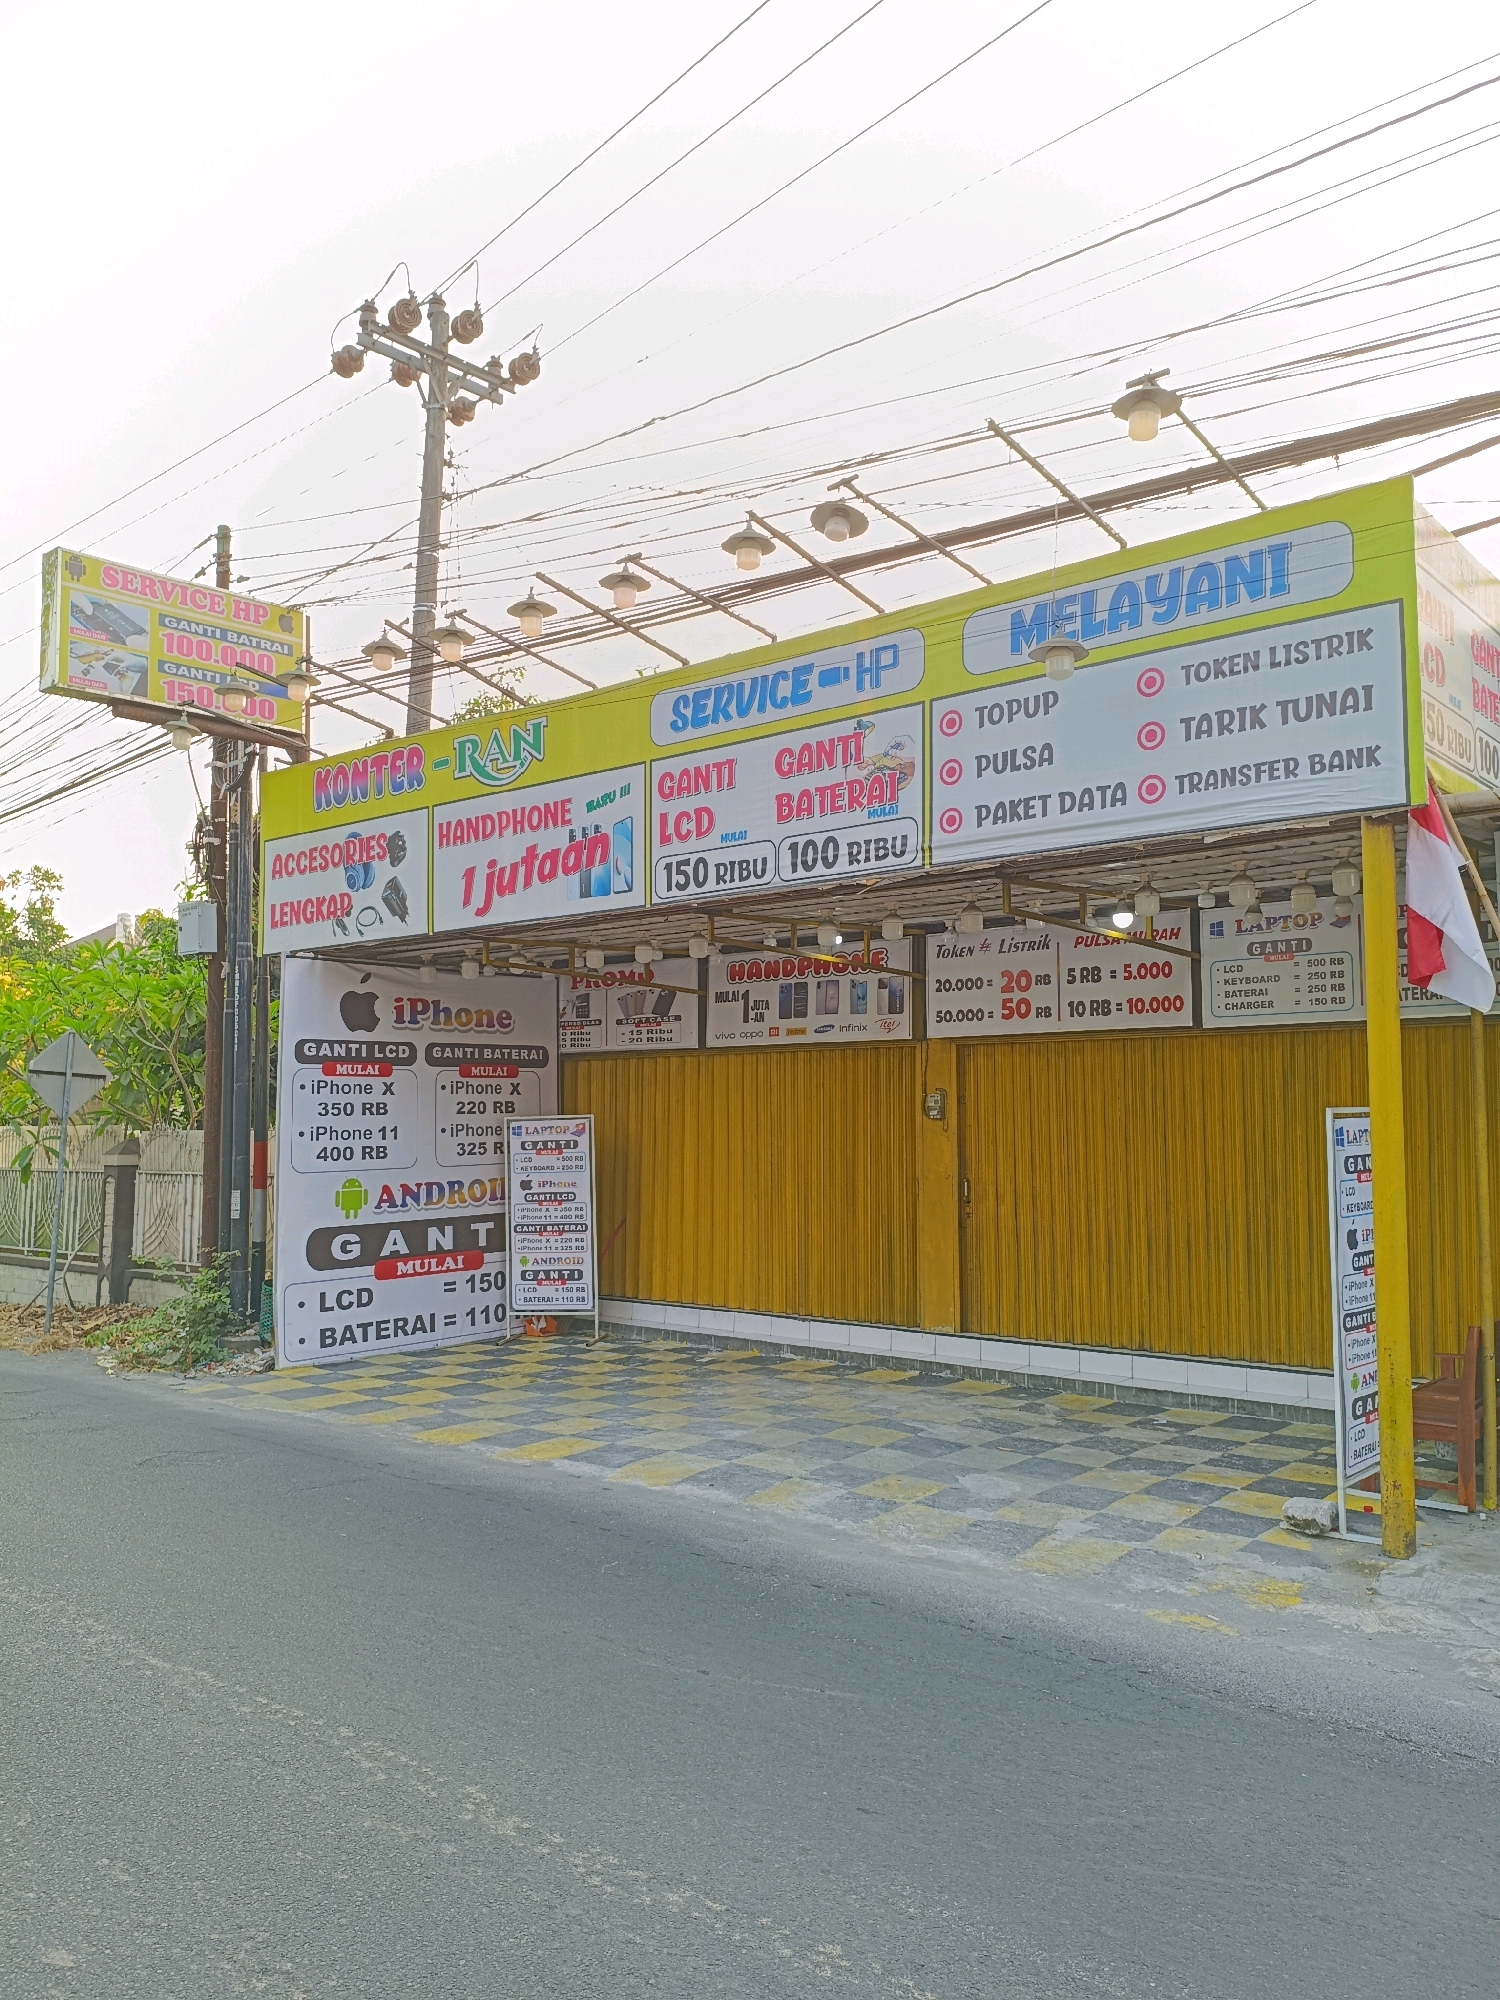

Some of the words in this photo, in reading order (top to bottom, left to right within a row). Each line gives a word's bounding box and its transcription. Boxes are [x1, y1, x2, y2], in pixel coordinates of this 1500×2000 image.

[102, 565, 225, 616] SERVICE
[232, 600, 269, 625] HP
[1009, 541, 1293, 656] MELAYANI
[73, 628, 92, 638] MULAI
[164, 616, 221, 639] GANTI
[226, 630, 289, 655] BATRAI
[161, 631, 274, 677] 100.000
[1180, 649, 1261, 687] TOKEN
[1268, 626, 1375, 670] LISTRIK
[1420, 641, 1446, 687] CD
[72, 678, 91, 686] MULAI
[163, 662, 220, 684] GANTI
[670, 662, 815, 733] SERVICE
[855, 643, 900, 693] HP
[974, 689, 1060, 730] TOPUP
[1472, 676, 1500, 727] BATE
[1179, 702, 1268, 744] TARIK
[1275, 683, 1375, 727] TUNAI
[774, 730, 867, 780] GANTI
[1446, 724, 1472, 764] RIBU
[313, 743, 426, 813] KONTER
[453, 716, 548, 786] RAN
[974, 742, 1055, 779] PULSA
[1174, 755, 1300, 797] TRANSFER
[1307, 744, 1383, 777] BANK
[657, 757, 738, 802] GANTI
[775, 770, 900, 824] BATERAI
[974, 793, 1052, 830] PAKET
[1058, 780, 1128, 816] DATA
[437, 797, 573, 849] HANDPHONE
[585, 790, 617, 814] BARU
[867, 804, 900, 820] MULAI
[658, 805, 717, 847] LCD
[720, 830, 748, 844] MULAI
[271, 832, 389, 880] ACCESORIES
[787, 835, 840, 875] 100
[846, 834, 909, 867] RIBU
[461, 865, 477, 910] 1
[474, 830, 612, 917] jutaan
[663, 856, 709, 893] 150
[714, 856, 769, 887] RIBU
[270, 891, 353, 930] LENGKAP
[1252, 940, 1308, 954] GANTI
[1066, 967, 1077, 984] 5
[1080, 966, 1102, 984] RB
[1123, 960, 1173, 981] 5.000
[1224, 964, 1244, 974] LCD
[1307, 958, 1326, 968] 500
[1330, 957, 1345, 966] RB
[935, 976, 984, 993] 20.000
[1000, 969, 1033, 994] 20
[1034, 974, 1052, 986] RB
[1224, 975, 1281, 986] KEYBOARD
[1308, 972, 1327, 980] 250
[1330, 970, 1345, 979] RB
[1224, 988, 1268, 998] BATERAI
[1308, 984, 1327, 994] 250
[1330, 983, 1346, 992] RB
[392, 996, 514, 1032] iPhone
[714, 990, 740, 1004] MULAI
[741, 989, 750, 1024] 1
[750, 1000, 770, 1011] JUTA
[935, 1008, 985, 1024] 50.000
[1001, 997, 1032, 1021] 50
[1035, 1006, 1052, 1019] RB
[1068, 1000, 1087, 1018] 10
[1090, 998, 1112, 1017] RB
[1126, 994, 1185, 1014] 10.000
[1224, 1000, 1274, 1011] CHARGER
[1308, 997, 1328, 1006] 150
[1330, 996, 1346, 1005] RB
[840, 1022, 868, 1032] Infinix
[303, 1042, 367, 1058] GANTI
[374, 1044, 411, 1059] LCD
[432, 1047, 479, 1059] GANTI
[484, 1048, 544, 1060] BATERAI
[335, 1064, 380, 1075] MULAI
[470, 1066, 508, 1077] MULAI
[311, 1079, 373, 1095] iPhone
[381, 1081, 396, 1096] X
[450, 1080, 503, 1095] iPhone
[509, 1082, 522, 1096] X
[317, 1102, 355, 1117] 350
[361, 1102, 389, 1116] RB
[456, 1101, 487, 1115] 220
[492, 1101, 516, 1114] RB
[310, 1125, 373, 1141] iPhone
[377, 1125, 399, 1141] 11
[450, 1123, 503, 1138] iPhone
[525, 1126, 570, 1135] LAPTOP
[316, 1146, 354, 1162] 400
[361, 1146, 388, 1160] RB
[456, 1142, 487, 1156] 325
[524, 1141, 574, 1150] GANTI
[1345, 1186, 1356, 1196] LCD
[330, 1221, 495, 1261] GANT
[396, 1255, 465, 1276] MULAI
[532, 1256, 584, 1266] ANDROID
[526, 1270, 578, 1280] GANTI
[1348, 1280, 1368, 1292] iPhone
[319, 1287, 374, 1313] LCD
[465, 1270, 506, 1294] 150
[1348, 1295, 1368, 1306] iPhone
[319, 1313, 436, 1349] BATERAI
[465, 1303, 507, 1327] 110
[1346, 1312, 1370, 1328] GANTI
[1350, 1336, 1370, 1349] iPhone
[1351, 1353, 1370, 1364] iPhone
[1354, 1428, 1366, 1443] LCD
